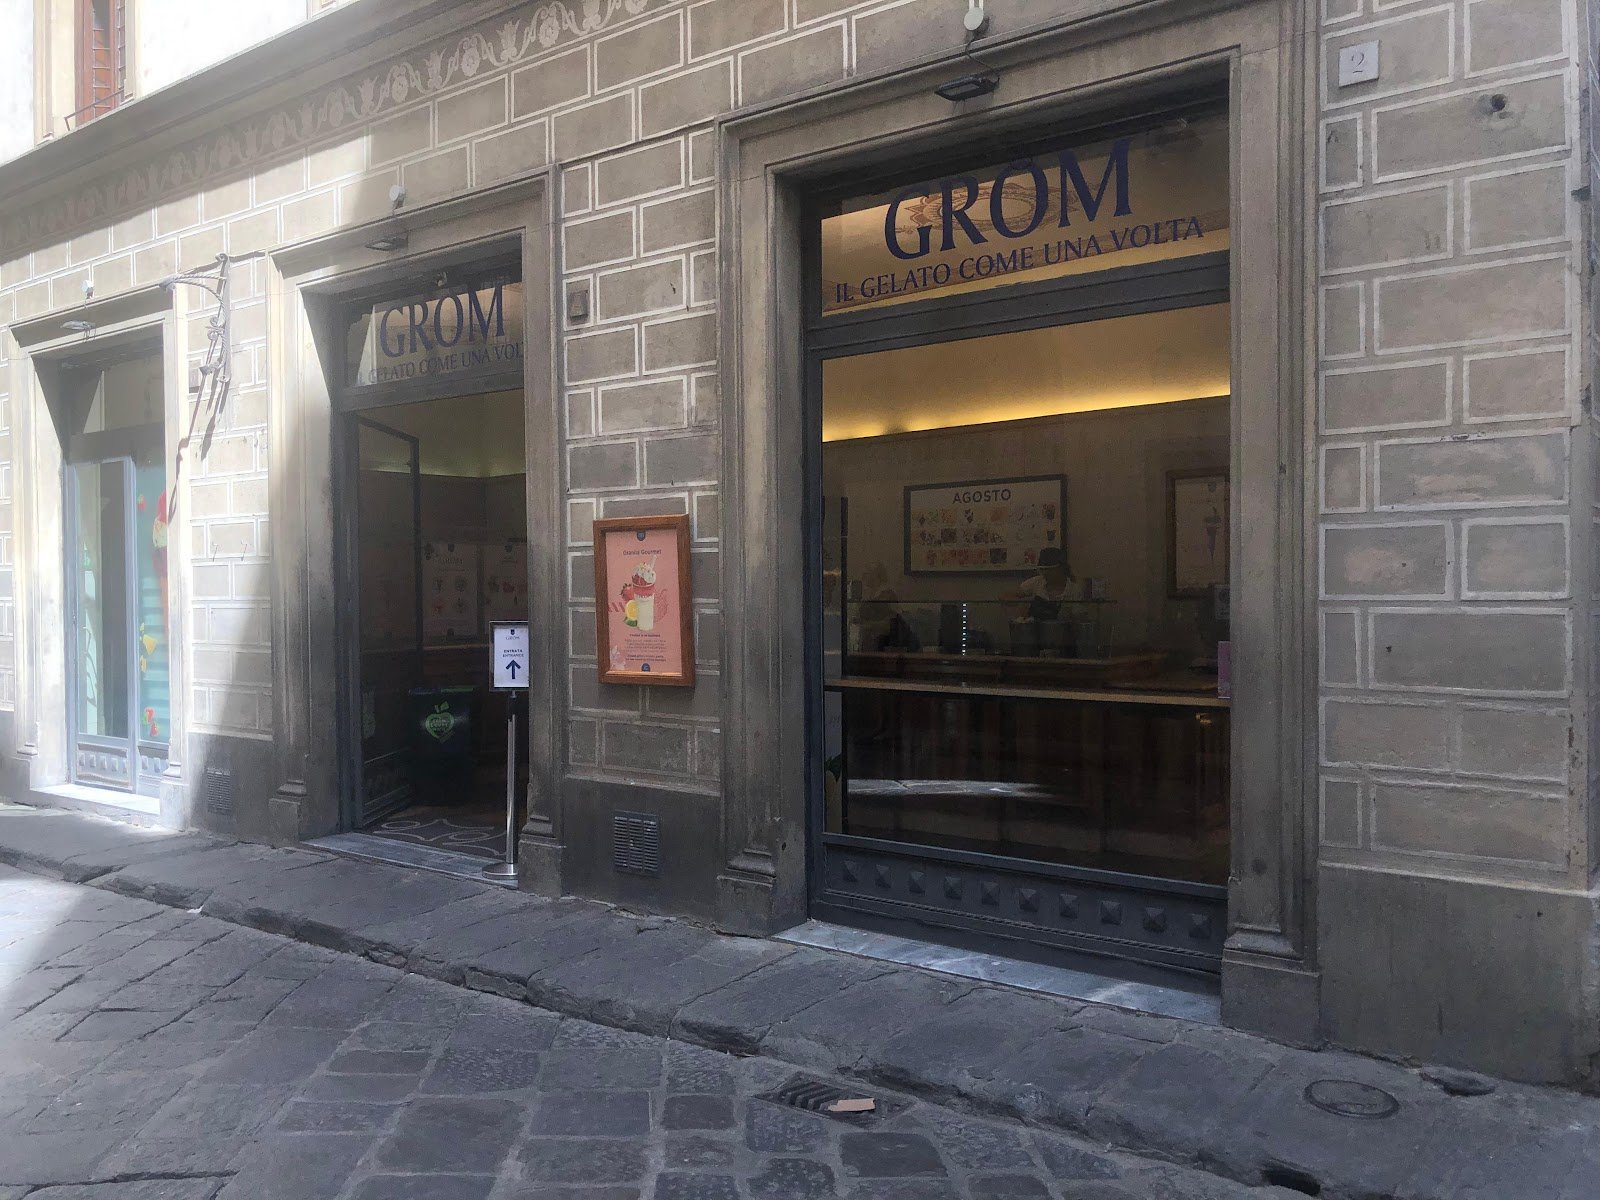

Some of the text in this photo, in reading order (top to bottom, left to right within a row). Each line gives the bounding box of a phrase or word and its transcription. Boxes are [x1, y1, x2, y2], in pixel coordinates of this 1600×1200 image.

[1351, 52, 1365, 74] 2
[884, 137, 1133, 261] GROM
[835, 216, 1205, 304] IL GELATO COME UNA VOLTA
[380, 279, 505, 358] GROM
[368, 361, 416, 384] GELATO
[419, 353, 458, 375] COME
[462, 347, 491, 368] UNA
[494, 341, 524, 361] VOL
[952, 488, 1012, 504] AGOSTO
